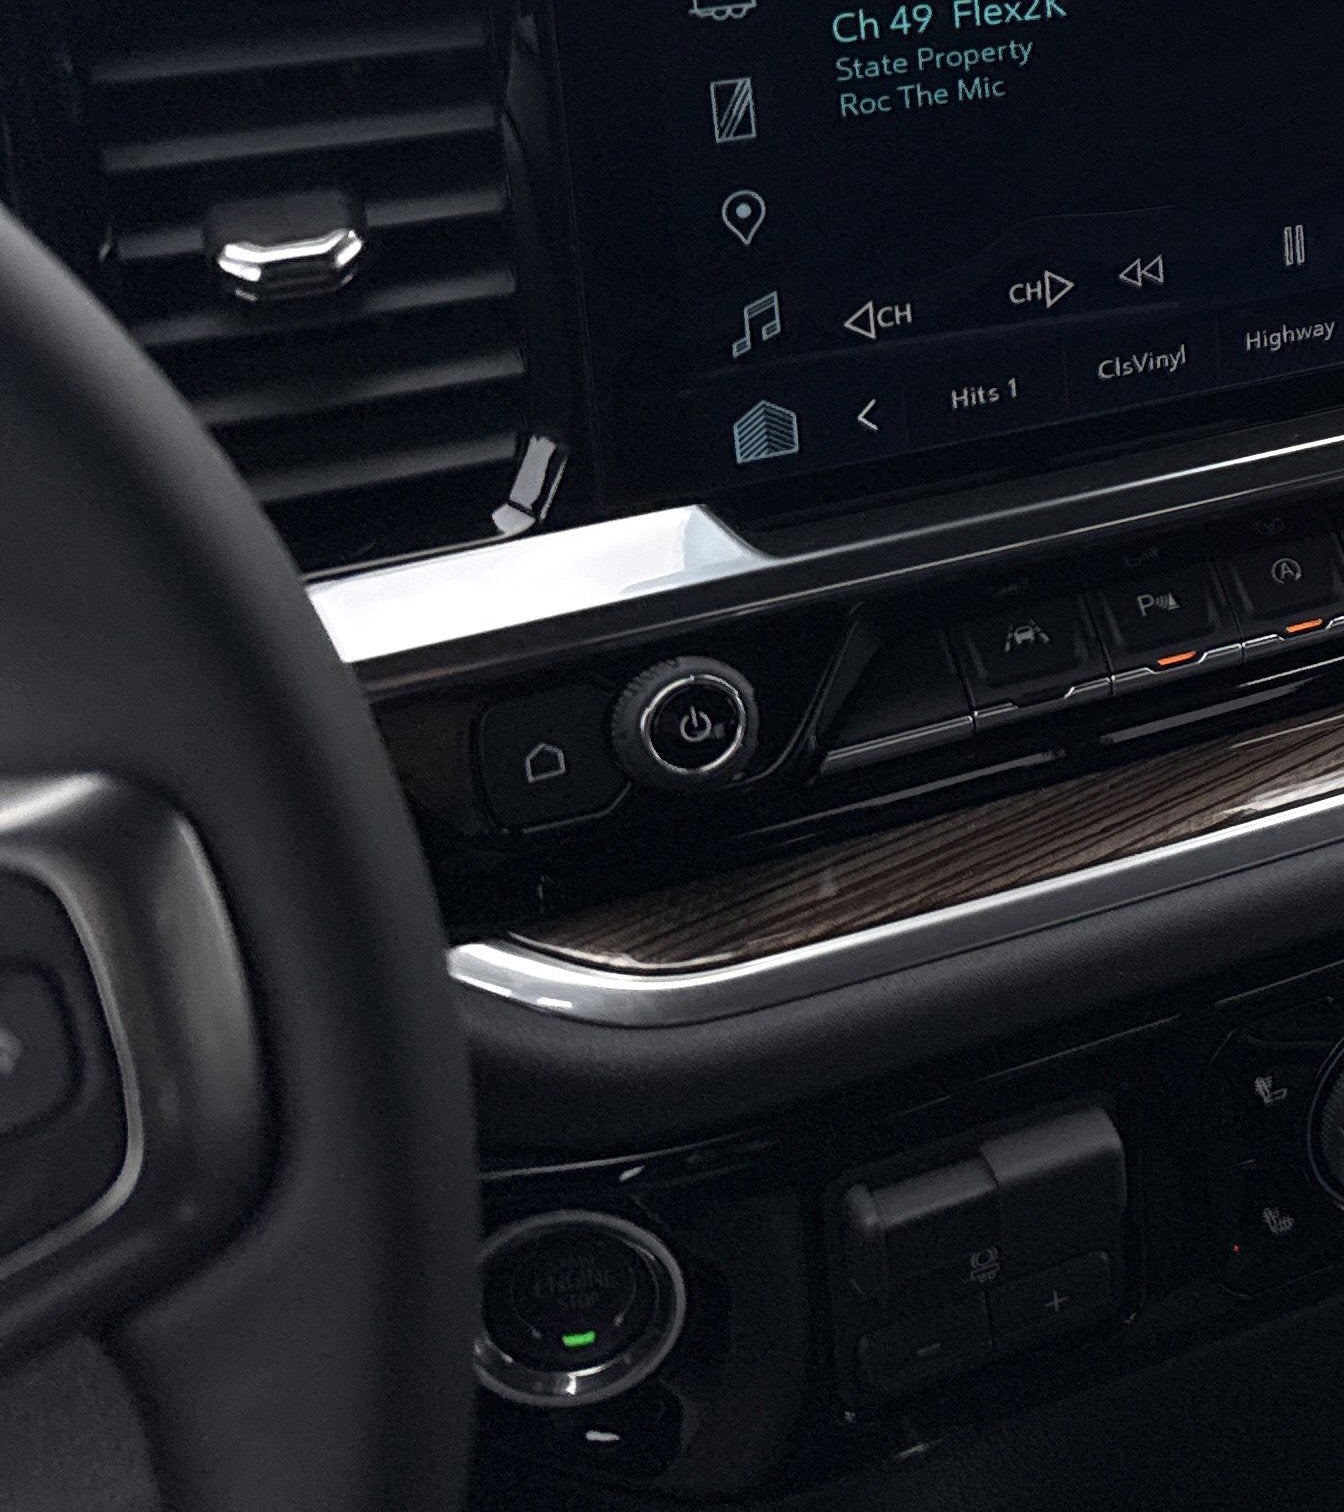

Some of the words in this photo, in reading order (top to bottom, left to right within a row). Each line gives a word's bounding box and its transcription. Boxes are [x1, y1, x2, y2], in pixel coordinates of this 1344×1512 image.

[831, 8, 880, 43] Ch
[889, 3, 934, 35] 49
[836, 54, 908, 82] State
[917, 40, 1033, 71] Property
[840, 92, 892, 117] Roc
[897, 83, 949, 109] The
[958, 76, 1006, 102] Mic
[1009, 280, 1042, 305] CH
[876, 302, 912, 328] CH
[1246, 320, 1336, 352] Highway
[1098, 343, 1187, 380] ClsVinyl
[951, 386, 1000, 409] Hits
[1008, 377, 1017, 399] 1
